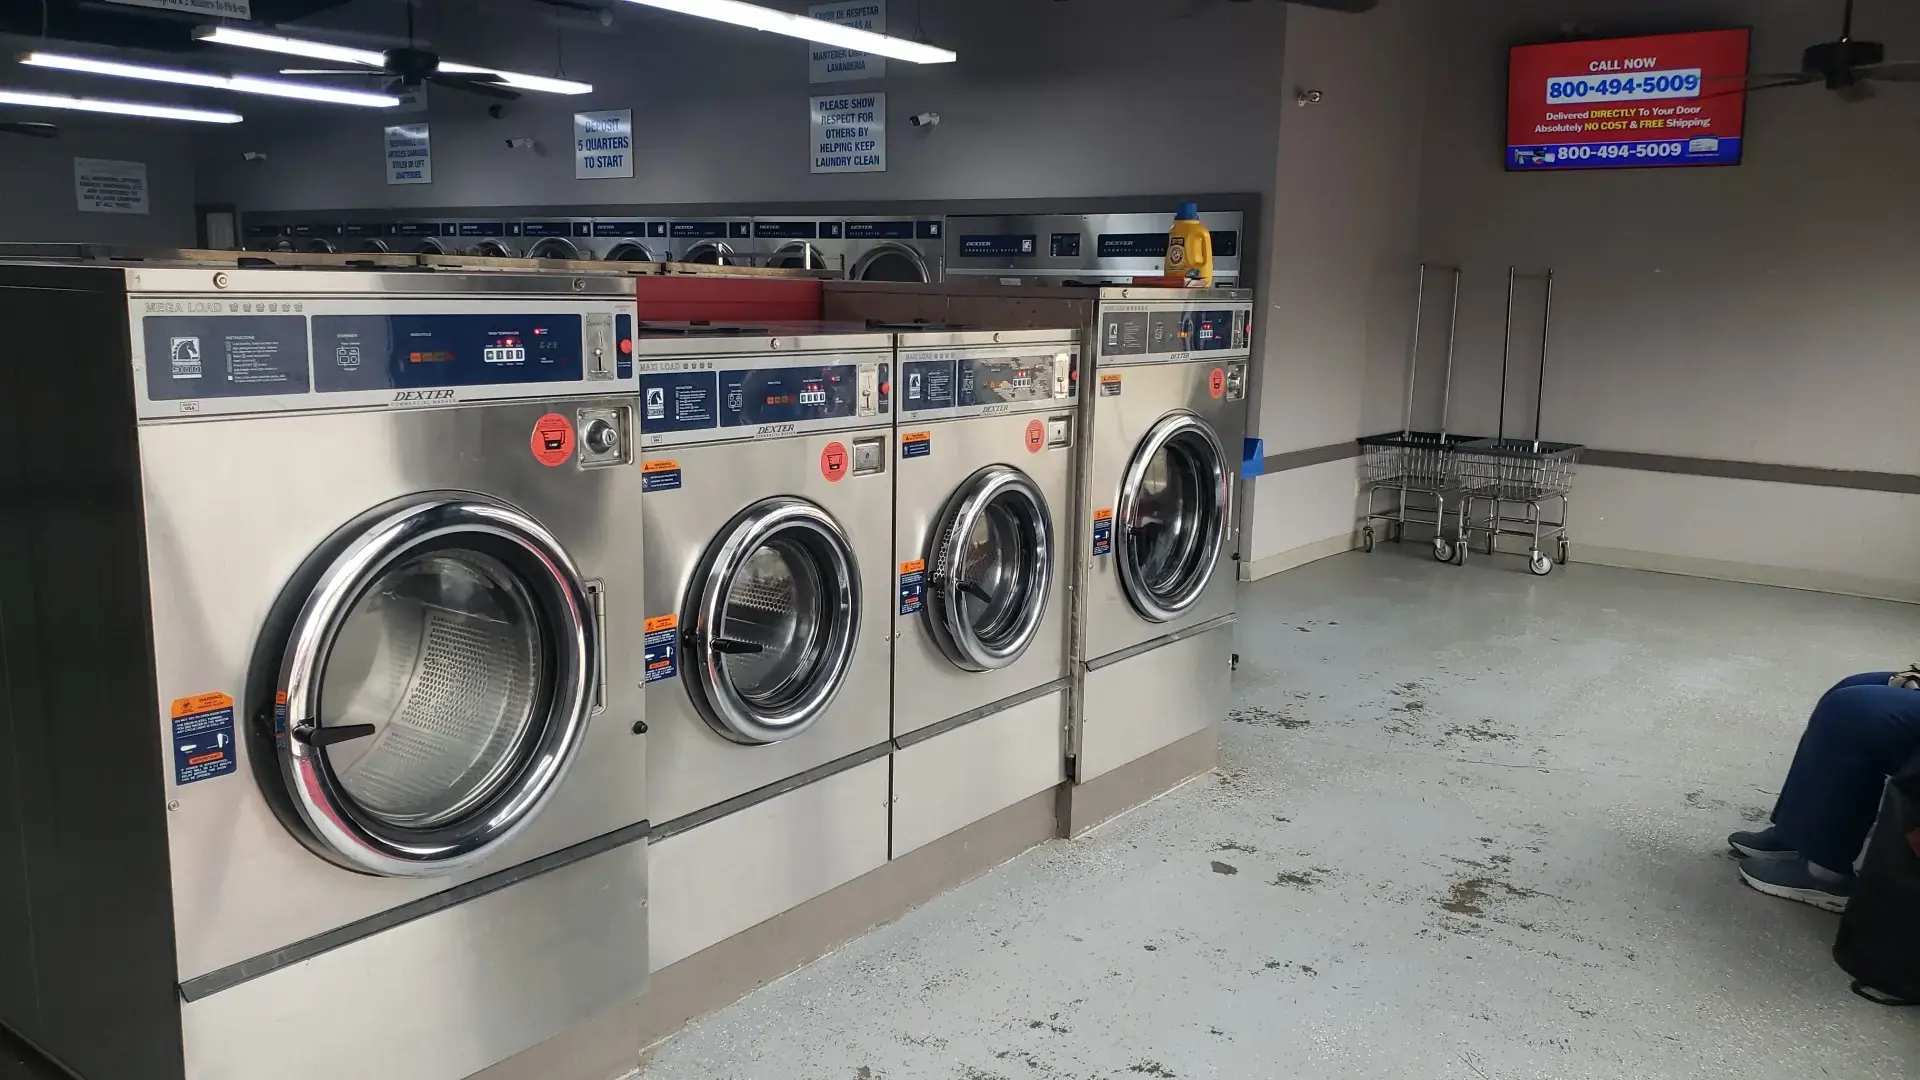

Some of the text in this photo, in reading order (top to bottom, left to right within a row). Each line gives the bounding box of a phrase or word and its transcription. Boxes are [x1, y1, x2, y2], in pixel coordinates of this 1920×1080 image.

[836, 9, 844, 19] DE
[846, 6, 878, 18] RESPETAR
[812, 50, 848, 60] MANTENER
[1589, 58, 1656, 72] CALL NOW
[1550, 74, 1699, 98] 800-494-5009
[820, 97, 875, 111] PLEASE SHOW
[822, 112, 874, 125] RESPECT FOR
[1546, 105, 1701, 120] Delivered DIRECTLY To Your Door
[586, 118, 620, 133] DEPOSIT
[1535, 118, 1711, 133] Absolutely NO COST & FREE Shipping
[826, 127, 869, 139] OTHERS BY
[578, 136, 629, 151] 5 QUARTERS
[820, 141, 875, 153] HELPING KEEP
[1557, 143, 1682, 160] 800-494-5009
[584, 155, 623, 168] TO START
[816, 155, 880, 167] LAUNDRY CLEAN
[145, 303, 222, 312] MEGA LOAD
[640, 363, 658, 371] MAXI
[660, 362, 680, 370] LOAD
[393, 389, 454, 401] DEXTER
[757, 424, 794, 434] DEXTER
